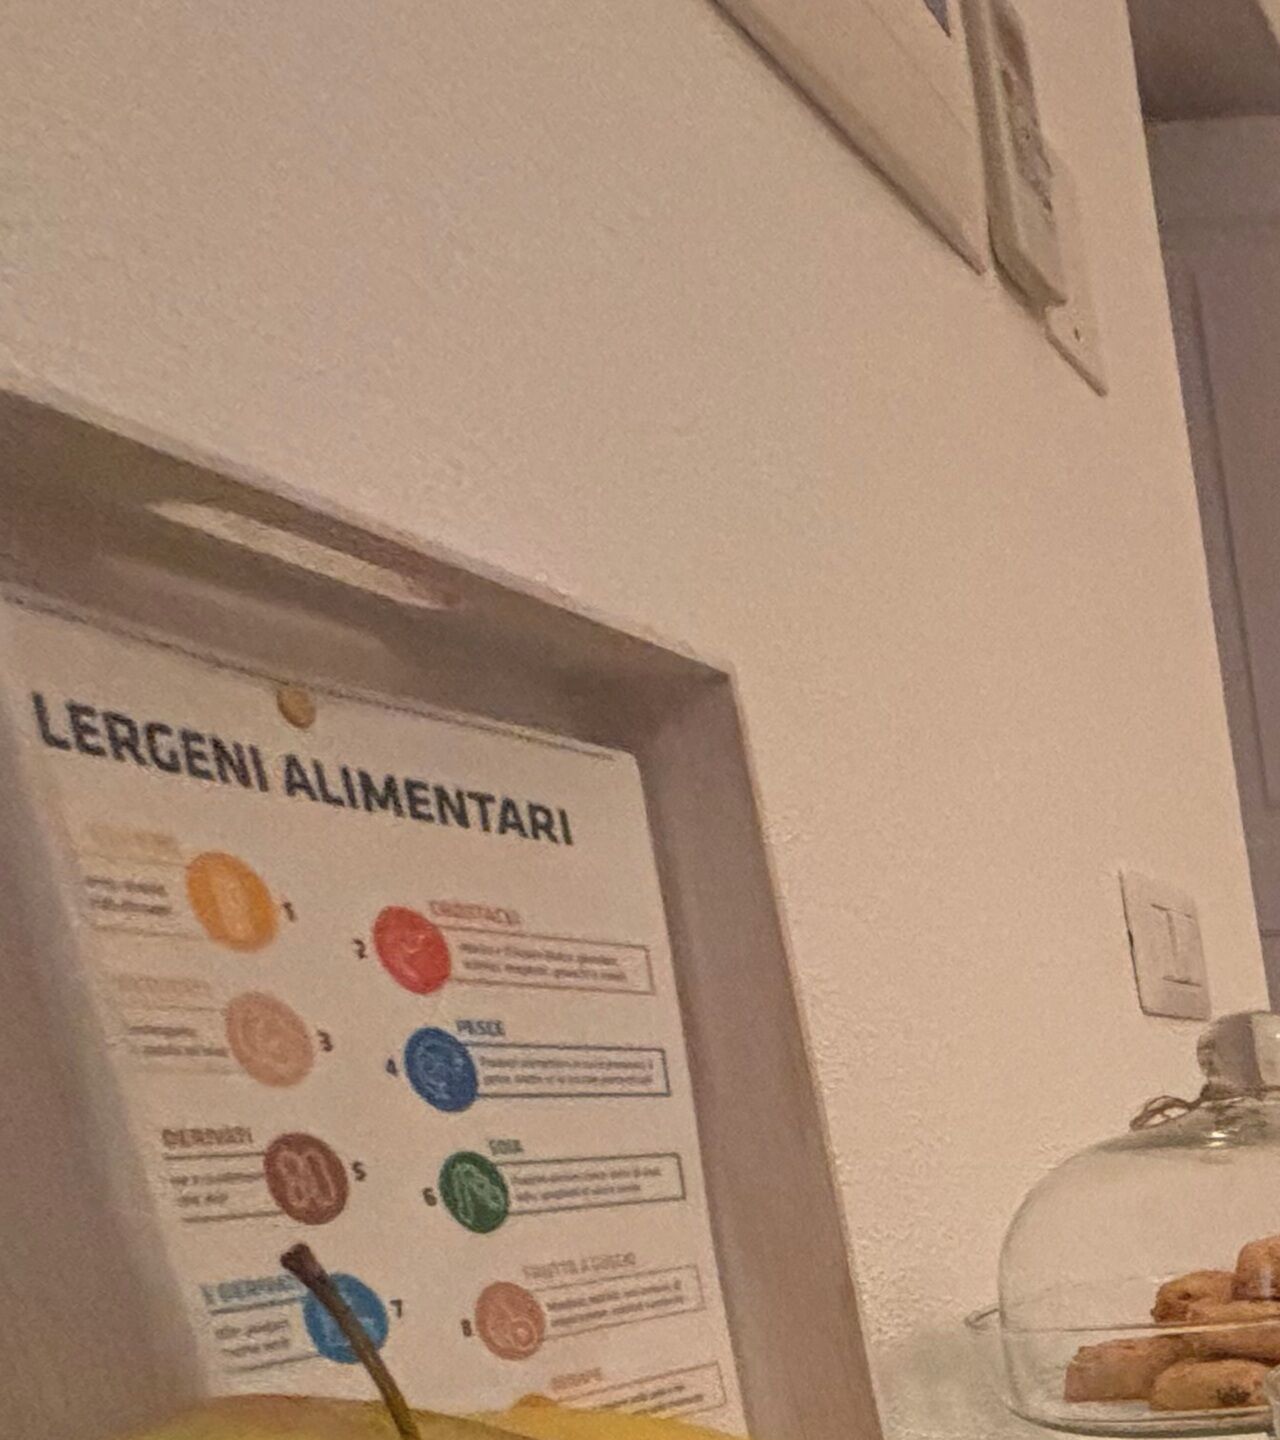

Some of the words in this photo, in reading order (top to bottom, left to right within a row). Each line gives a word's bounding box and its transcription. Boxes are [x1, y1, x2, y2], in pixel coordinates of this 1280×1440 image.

[31, 692, 270, 793] LERGENI
[283, 754, 575, 846] ALIMENTARI
[353, 938, 366, 959] 2
[317, 1025, 333, 1052] 3
[386, 1057, 398, 1077] 4
[352, 1160, 366, 1181] 5
[423, 1187, 437, 1206] 6
[391, 1298, 402, 1318] 7
[461, 1319, 472, 1337] 8
